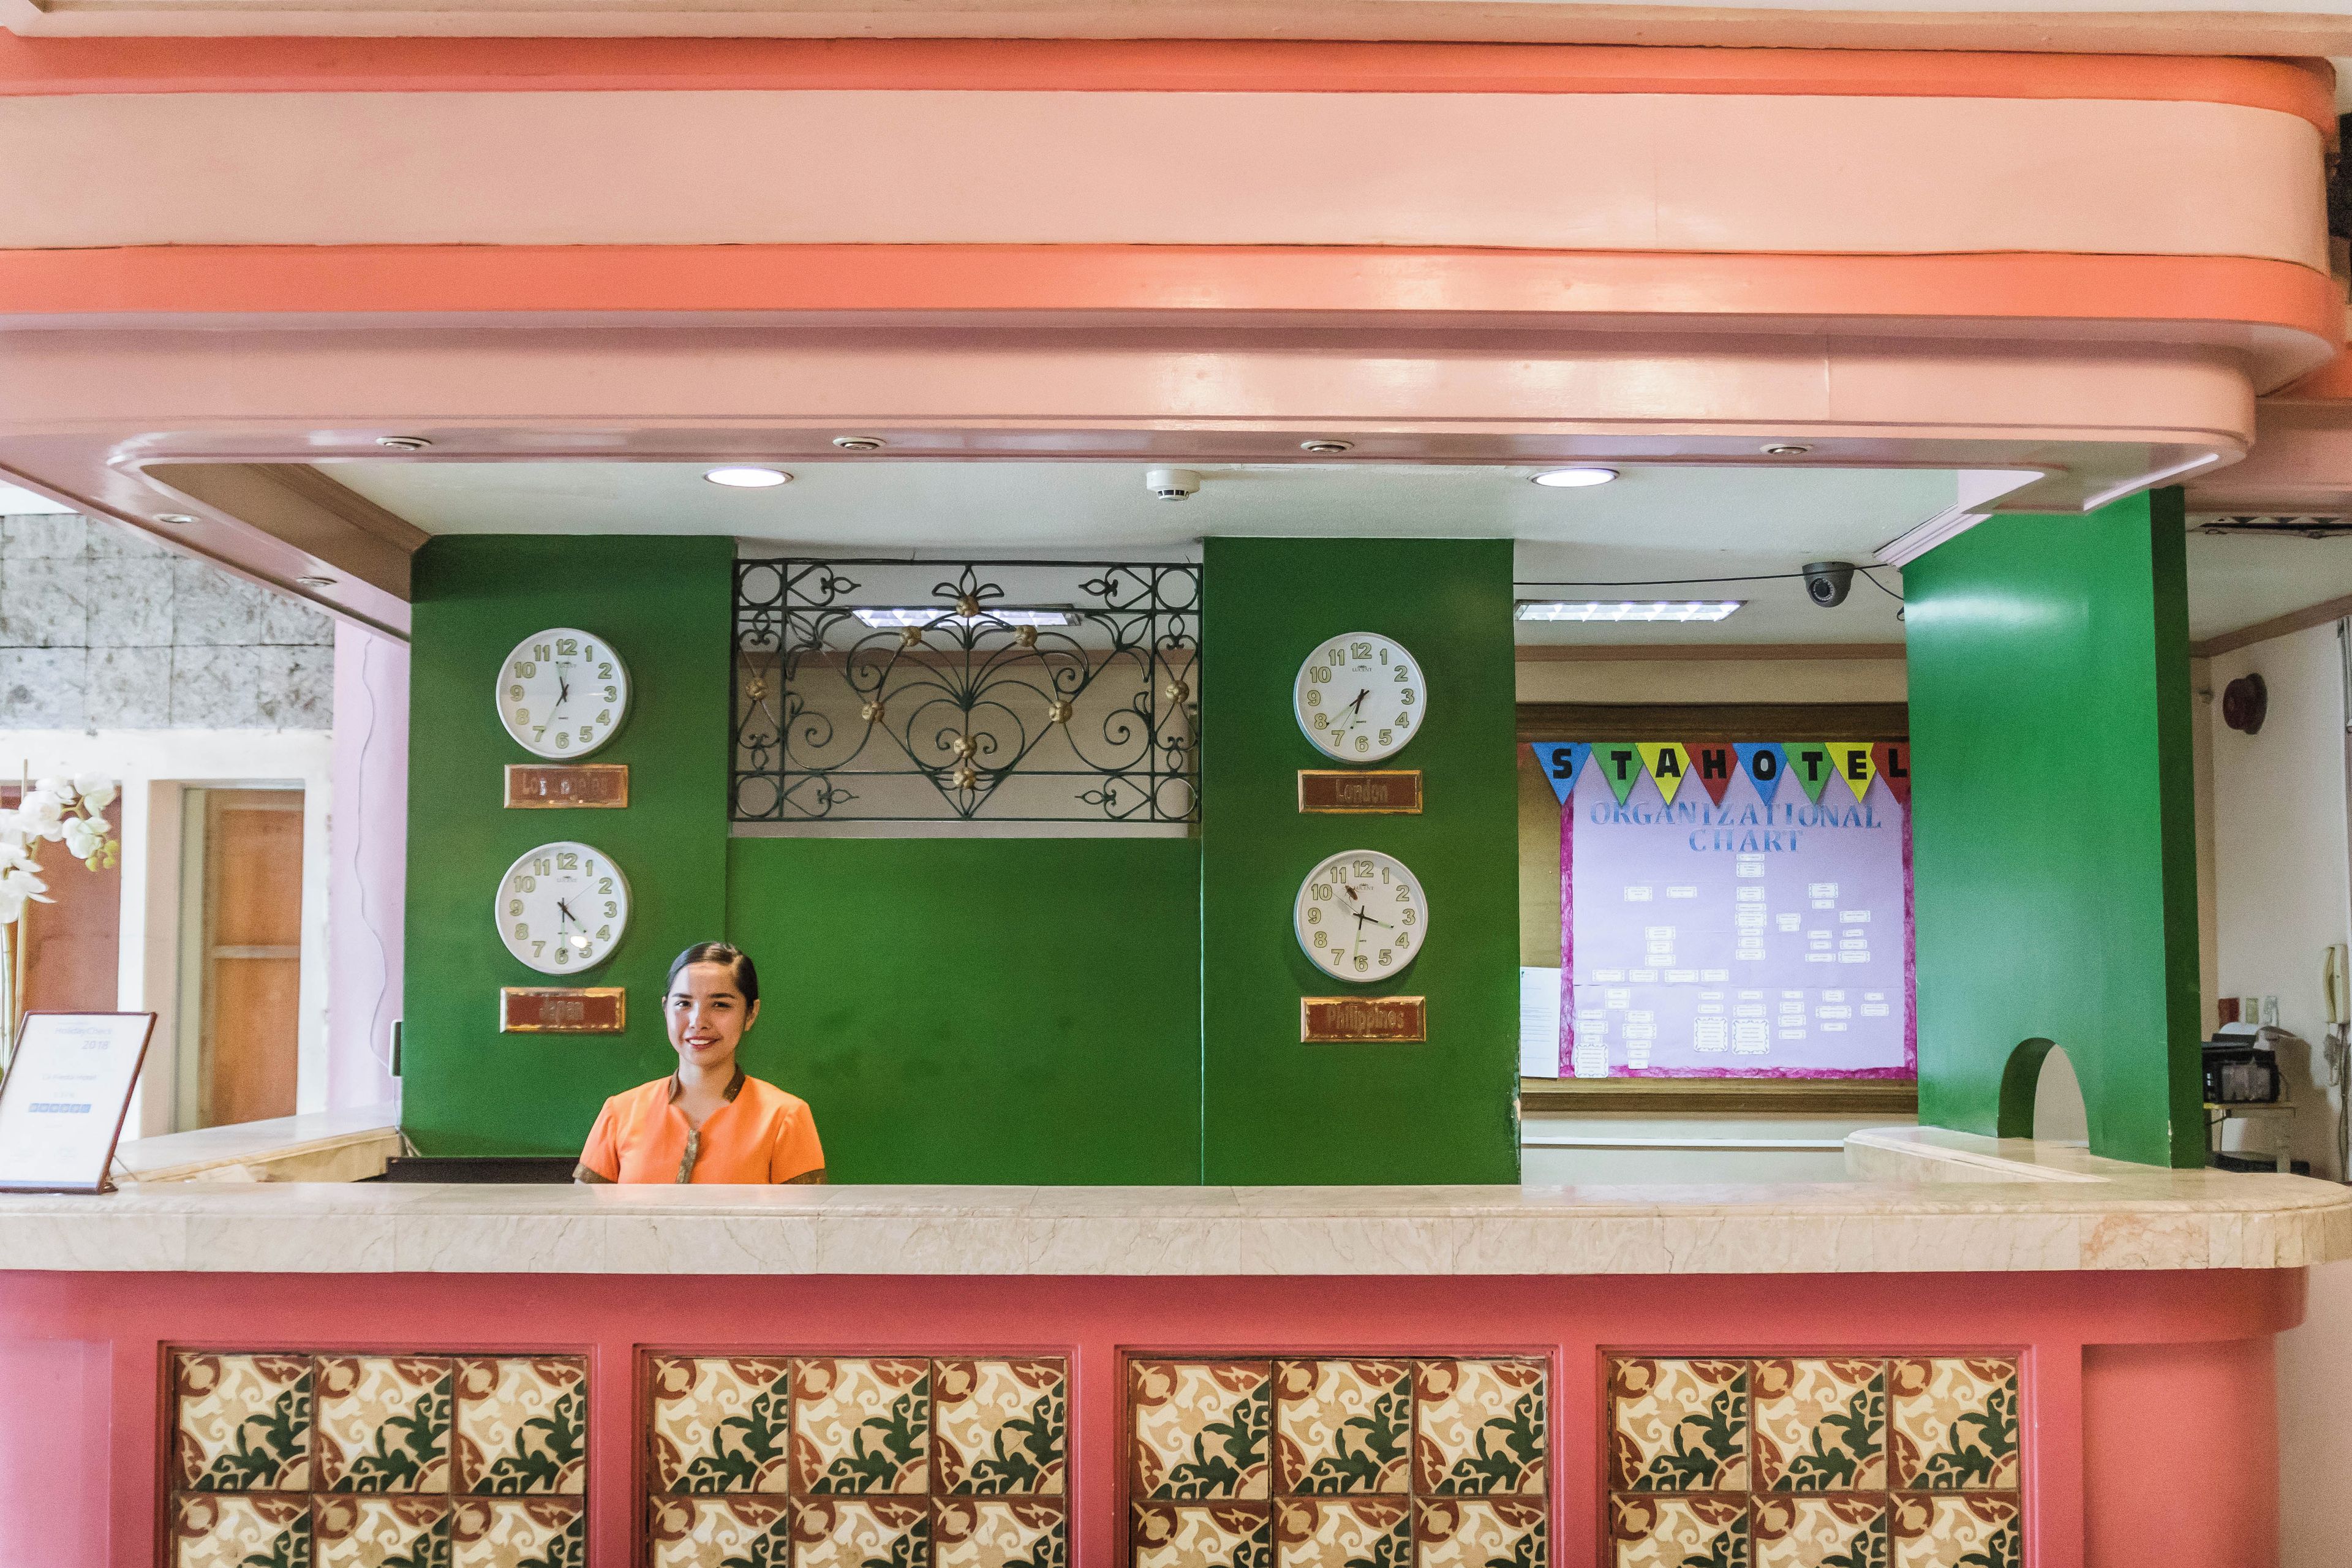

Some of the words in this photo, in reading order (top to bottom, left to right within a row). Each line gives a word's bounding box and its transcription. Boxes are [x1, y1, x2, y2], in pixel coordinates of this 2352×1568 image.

[533, 645, 549, 662] 11
[556, 639, 577, 655] 12
[585, 646, 592, 662] 1
[1351, 643, 1372, 659] 12
[1329, 649, 1345, 666] 11
[1380, 649, 1387, 665] 1
[514, 662, 536, 678] 10
[598, 663, 612, 679] 2
[1310, 666, 1331, 683] 10
[1394, 666, 1408, 682] 2
[510, 685, 524, 702] 9
[604, 686, 617, 703] 3
[1307, 690, 1321, 706] 9
[1401, 688, 1414, 704] 3
[515, 709, 529, 725] 8
[596, 709, 610, 725] 4
[1314, 714, 1327, 729] 8
[1395, 712, 1409, 728] 4
[533, 726, 545, 742] 7
[555, 733, 569, 748] 6
[579, 726, 593, 742] 5
[1332, 730, 1344, 746] 7
[1379, 729, 1392, 745] 5
[1355, 736, 1368, 752] 6
[1336, 779, 1389, 804] London
[1590, 801, 1881, 828] ORGANIZATIONAL
[1689, 829, 1803, 853] CHART
[533, 859, 550, 876] 11
[557, 853, 578, 870] 12
[586, 859, 593, 876] 1
[1353, 861, 1374, 877] 12
[1330, 867, 1346, 883] 11
[1382, 867, 1390, 884] 1
[514, 876, 535, 892] 10
[598, 878, 612, 894] 2
[1311, 884, 1332, 901] 10
[1396, 885, 1409, 902] 2
[509, 900, 523, 916] 9
[604, 901, 617, 918] 3
[1308, 908, 1321, 924] 9
[1402, 908, 1415, 925] 3
[514, 924, 528, 940] 8
[596, 925, 610, 941] 4
[1314, 931, 1327, 948] 8
[1395, 932, 1409, 948] 4
[532, 941, 545, 957] 7
[555, 948, 568, 965] 6
[579, 941, 592, 958] 5
[1331, 949, 1344, 965] 7
[1355, 956, 1368, 972] 6
[1379, 949, 1392, 966] 5
[81, 1040, 110, 1050] 2018
